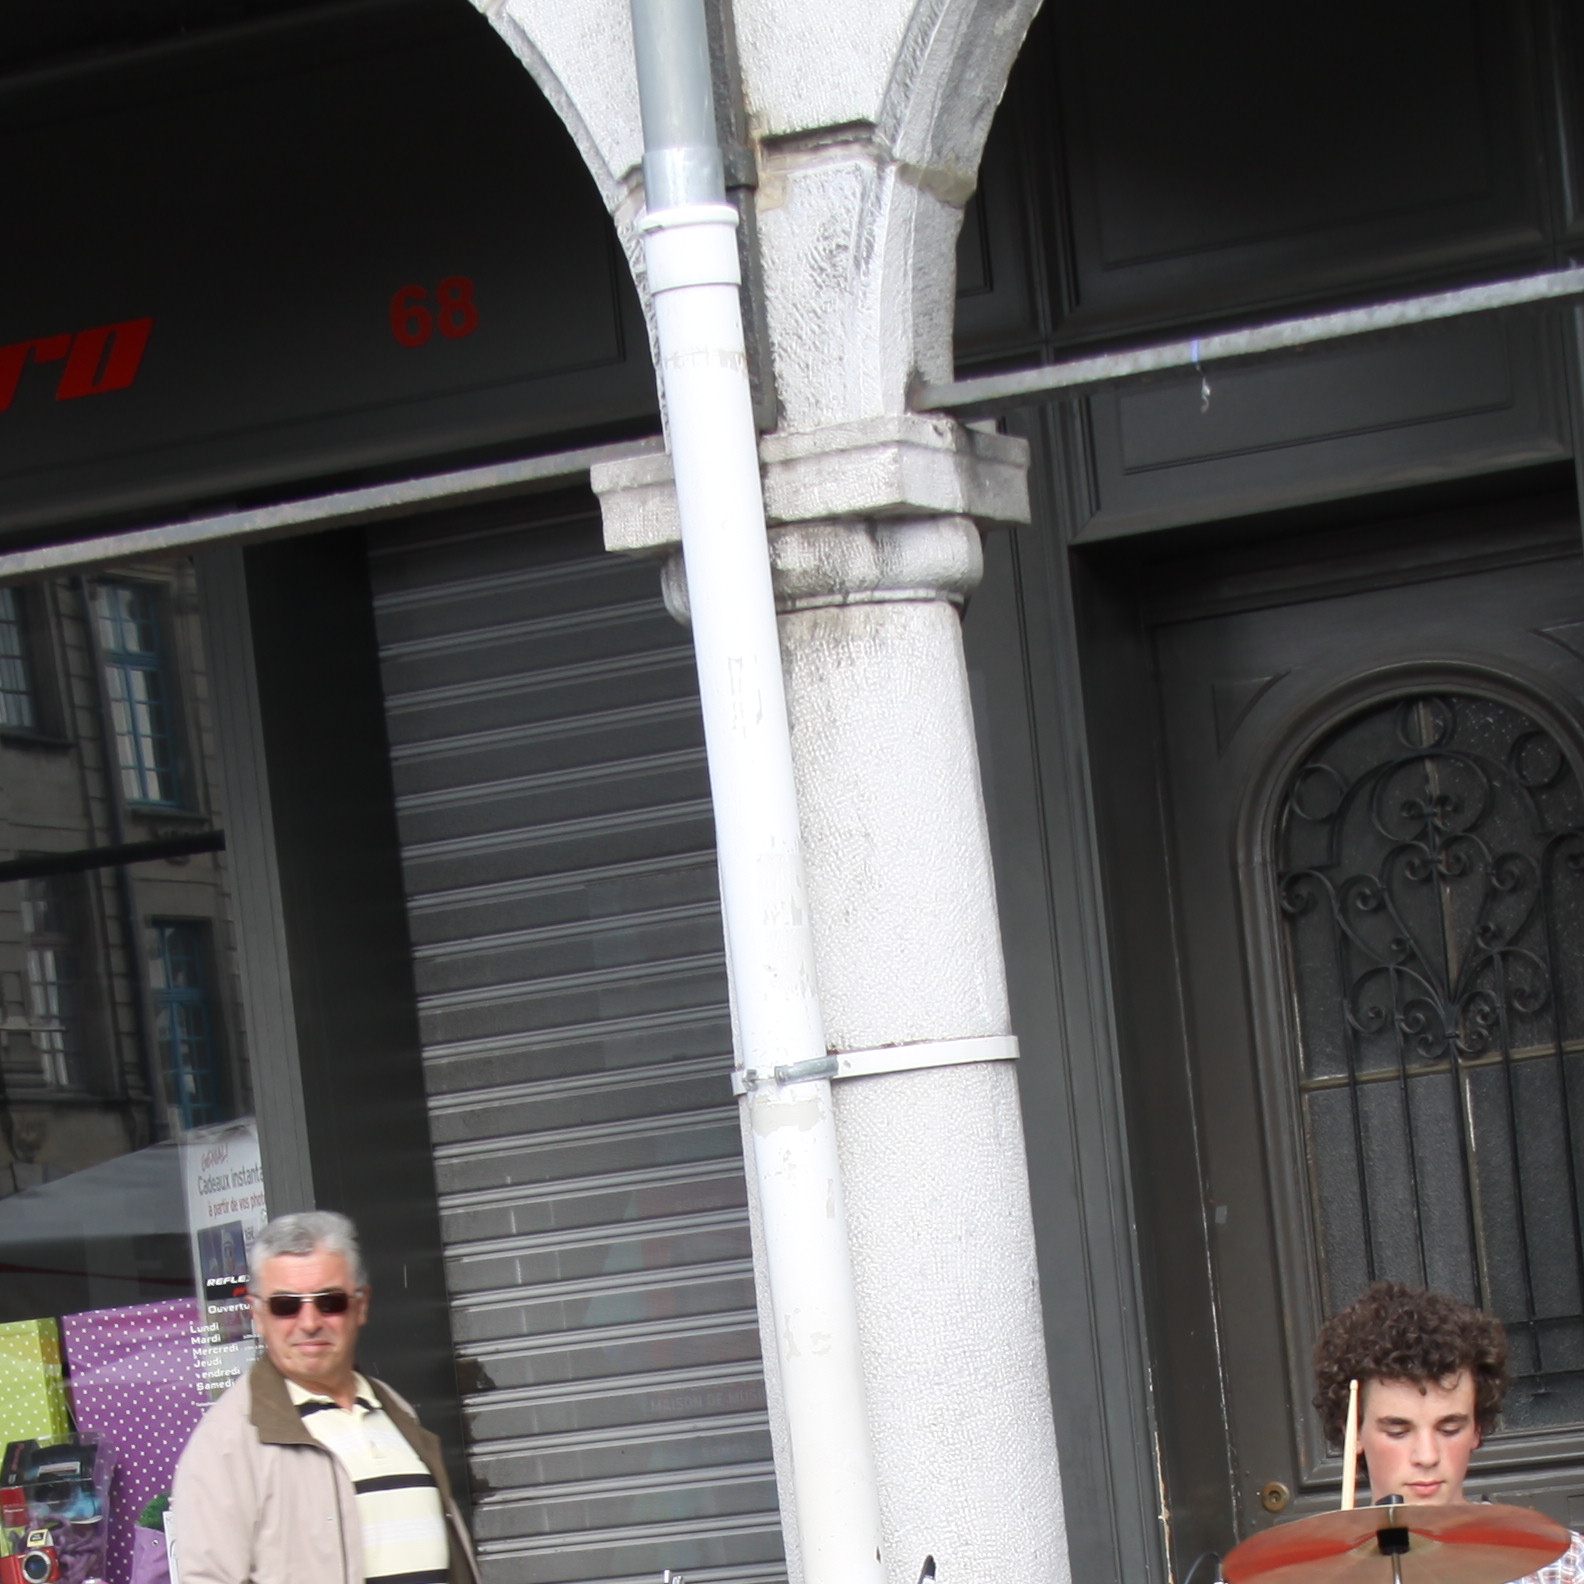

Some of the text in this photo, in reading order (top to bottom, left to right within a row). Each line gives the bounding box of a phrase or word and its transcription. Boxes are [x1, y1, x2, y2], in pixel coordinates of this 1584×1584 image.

[389, 276, 479, 348] 68
[207, 1303, 250, 1314] Ouvertu
[190, 1322, 219, 1334] Lundi
[191, 1333, 222, 1345] Mardi
[192, 1344, 239, 1357] Mercredi
[194, 1357, 222, 1368] Jeudi
